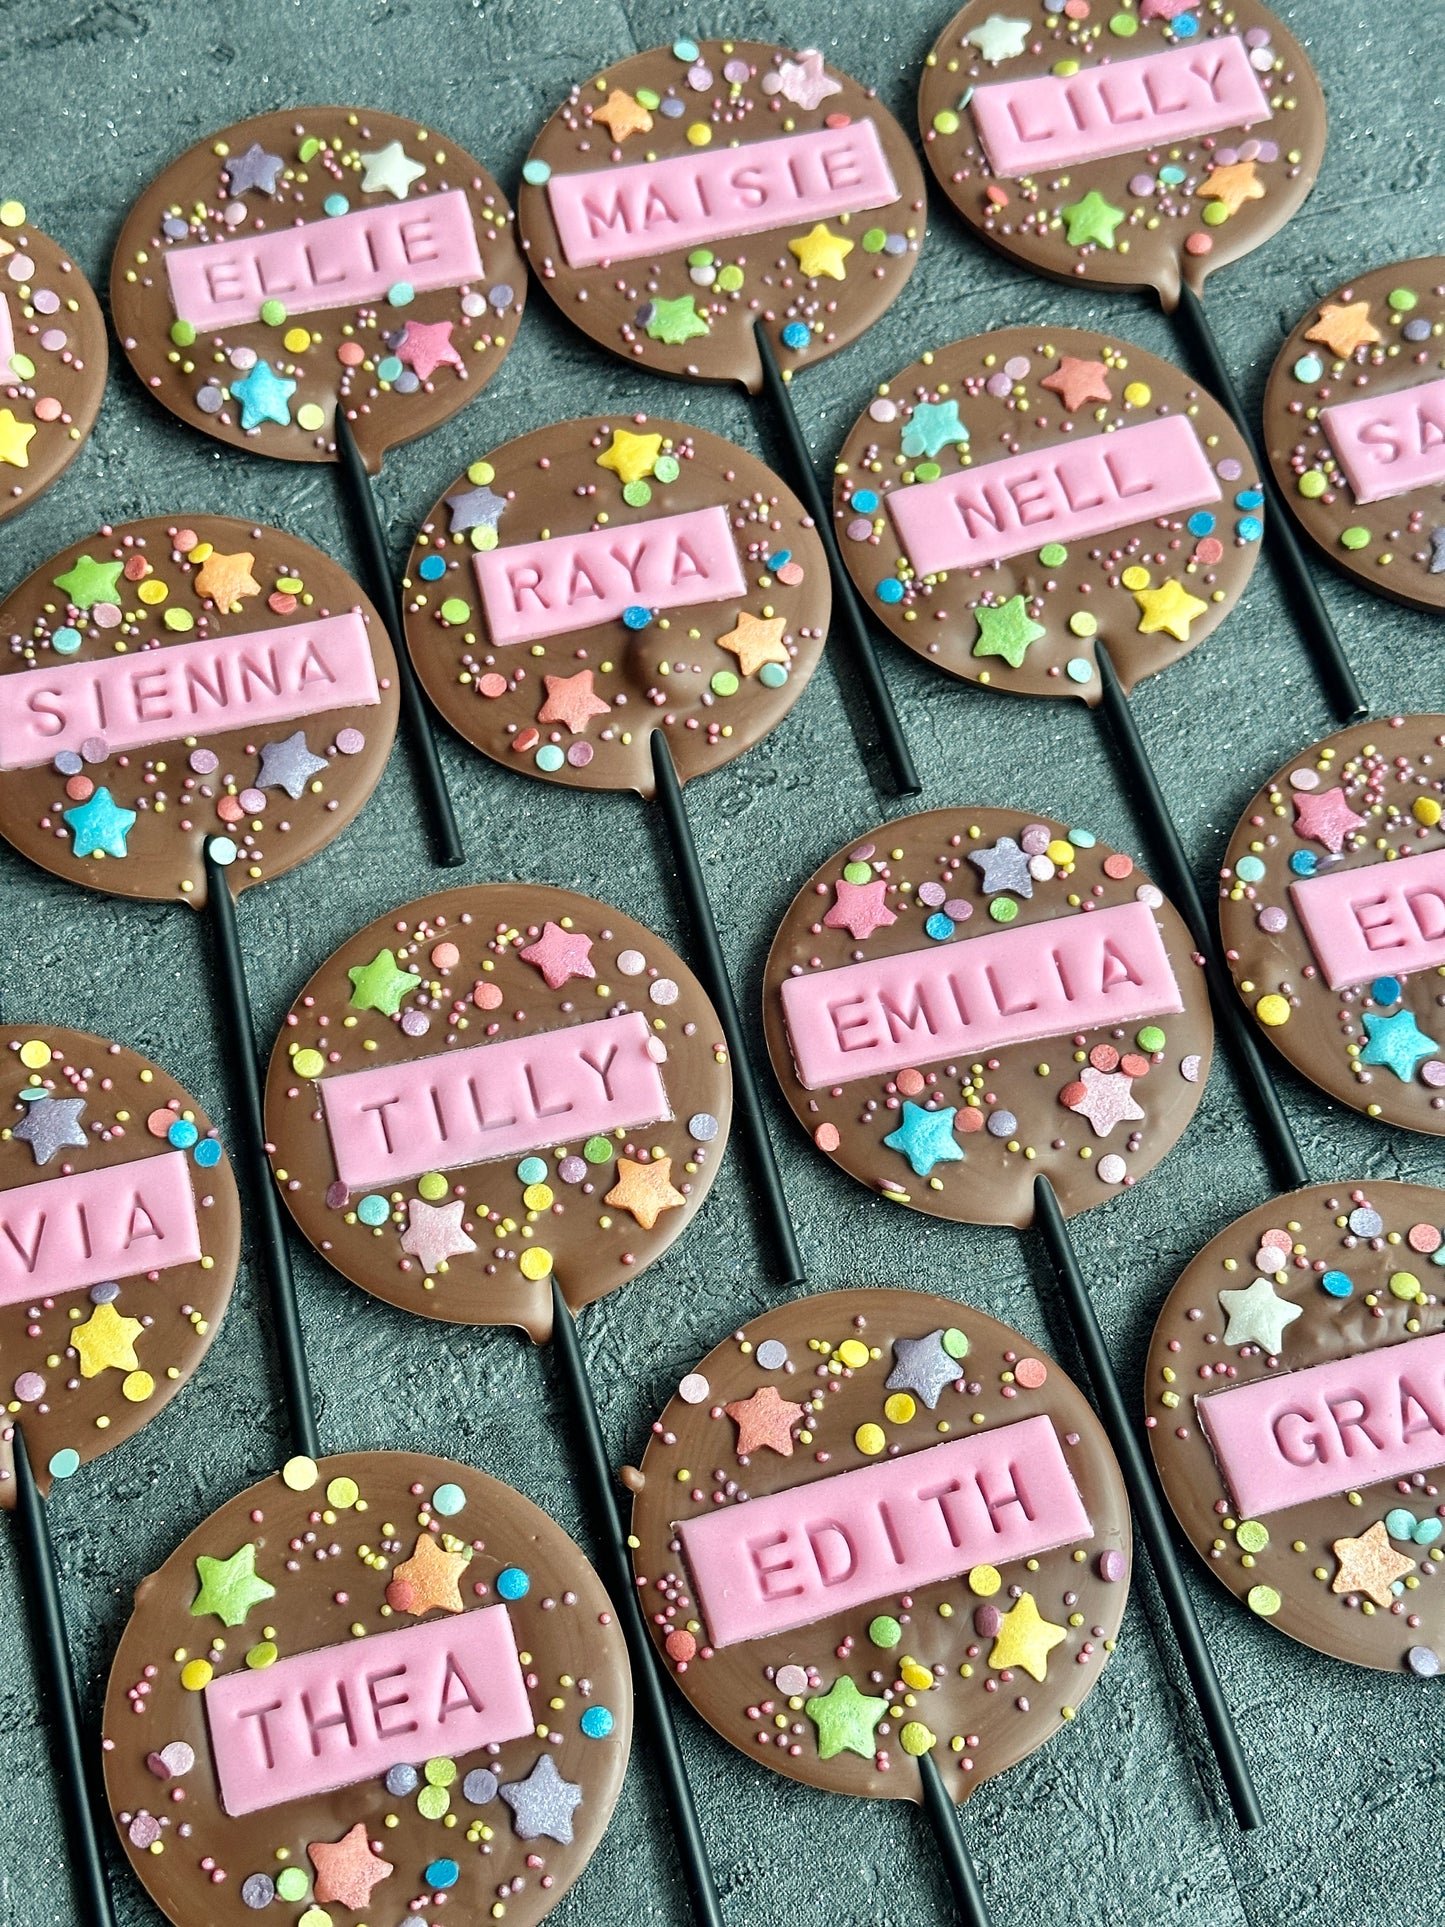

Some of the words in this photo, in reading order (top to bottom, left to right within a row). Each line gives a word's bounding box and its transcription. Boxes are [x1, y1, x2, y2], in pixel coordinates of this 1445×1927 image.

[1007, 50, 1238, 143] LILLY
[582, 146, 863, 240] MAISIE
[205, 214, 441, 304] ELLIE
[953, 451, 1154, 540] NELL
[506, 534, 710, 615] RAYA
[27, 640, 337, 738] SIENNA
[827, 937, 1144, 1053] EMILIA
[360, 1043, 619, 1154] TILLY
[2, 1189, 165, 1273] VIA
[746, 1462, 1037, 1602] EDITH
[237, 1650, 484, 1770] THEA
